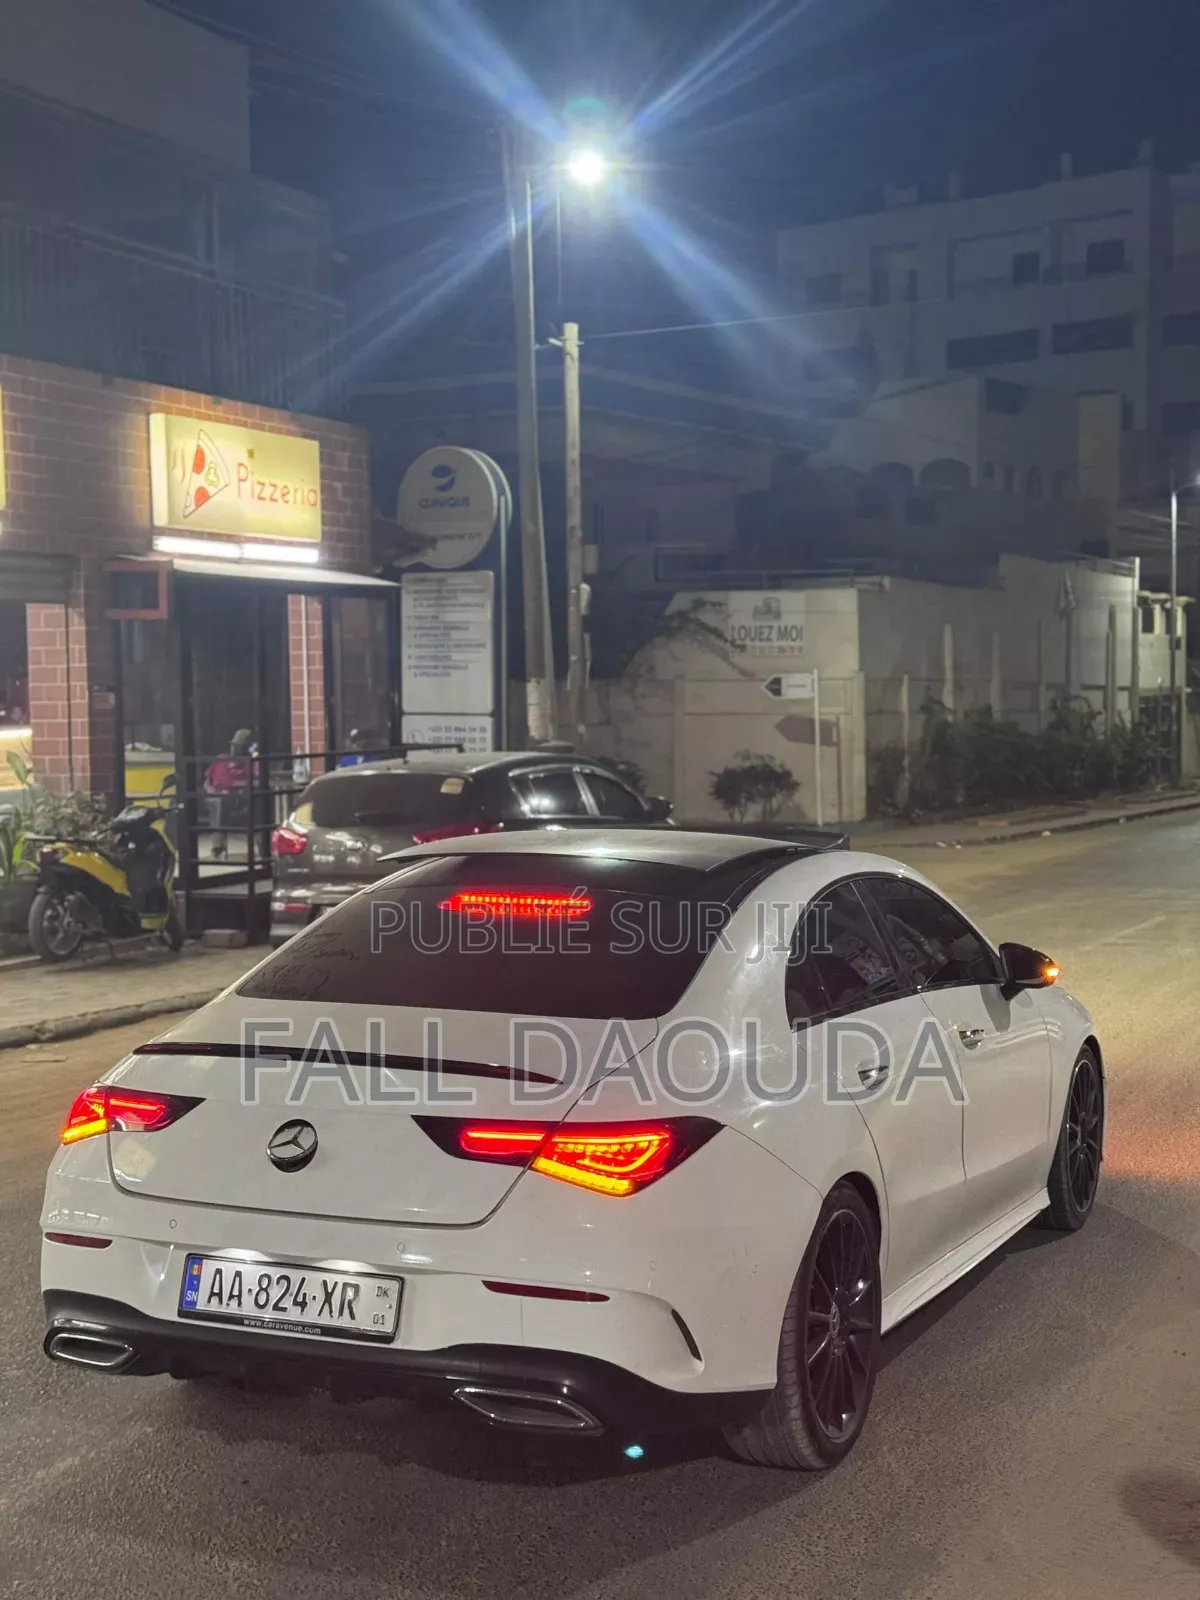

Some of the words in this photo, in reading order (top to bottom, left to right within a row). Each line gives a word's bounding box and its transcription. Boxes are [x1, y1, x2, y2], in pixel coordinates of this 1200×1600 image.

[236, 461, 319, 508] Pizzeria
[776, 624, 804, 642] MOI
[186, 1290, 199, 1302] SN
[375, 1285, 391, 1298] DK
[372, 1313, 385, 1325] 01
